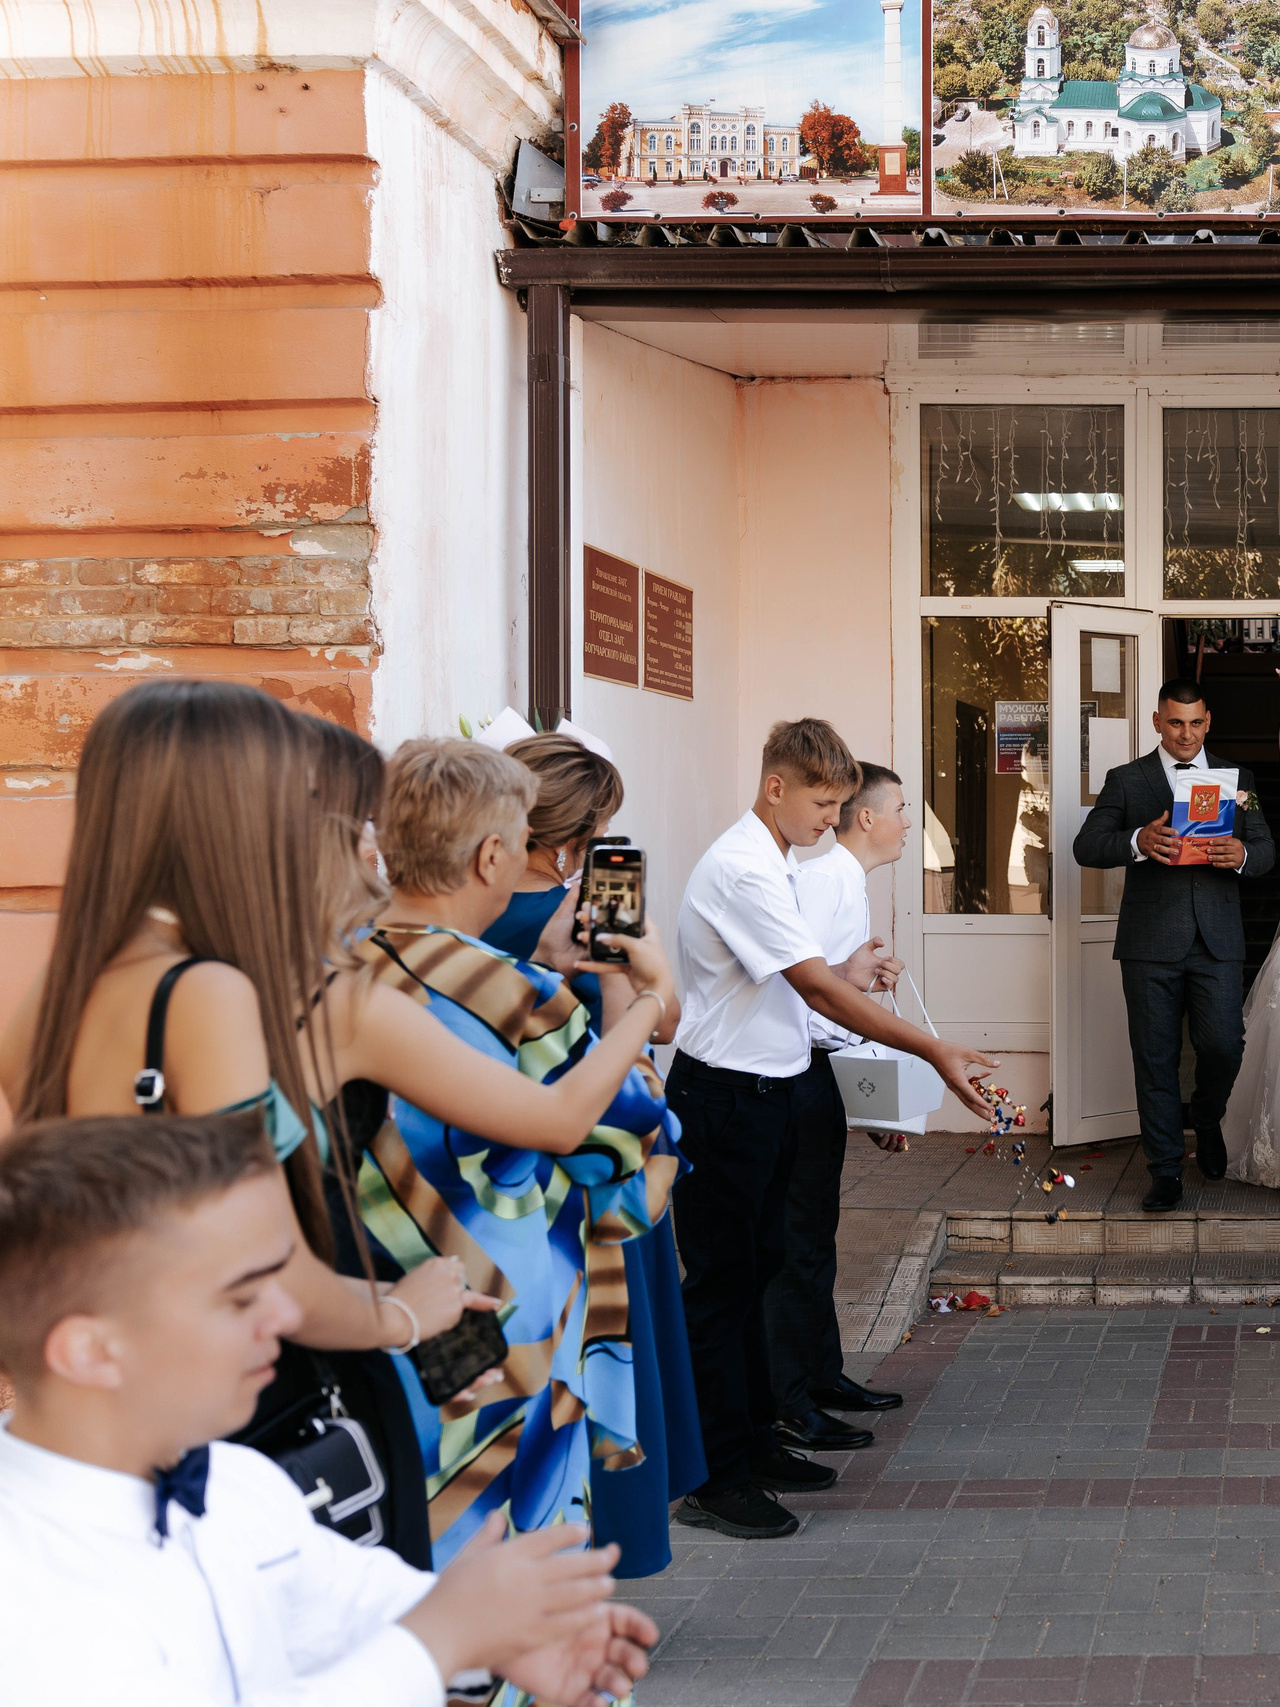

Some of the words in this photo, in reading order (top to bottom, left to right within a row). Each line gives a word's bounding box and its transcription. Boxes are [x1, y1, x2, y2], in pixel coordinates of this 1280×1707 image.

[589, 609, 634, 633] ТЕРРИТОРИАЛЬНЫЙ
[598, 629, 614, 644] ОТДЕЛ
[999, 713, 1042, 722] РАБОТА
